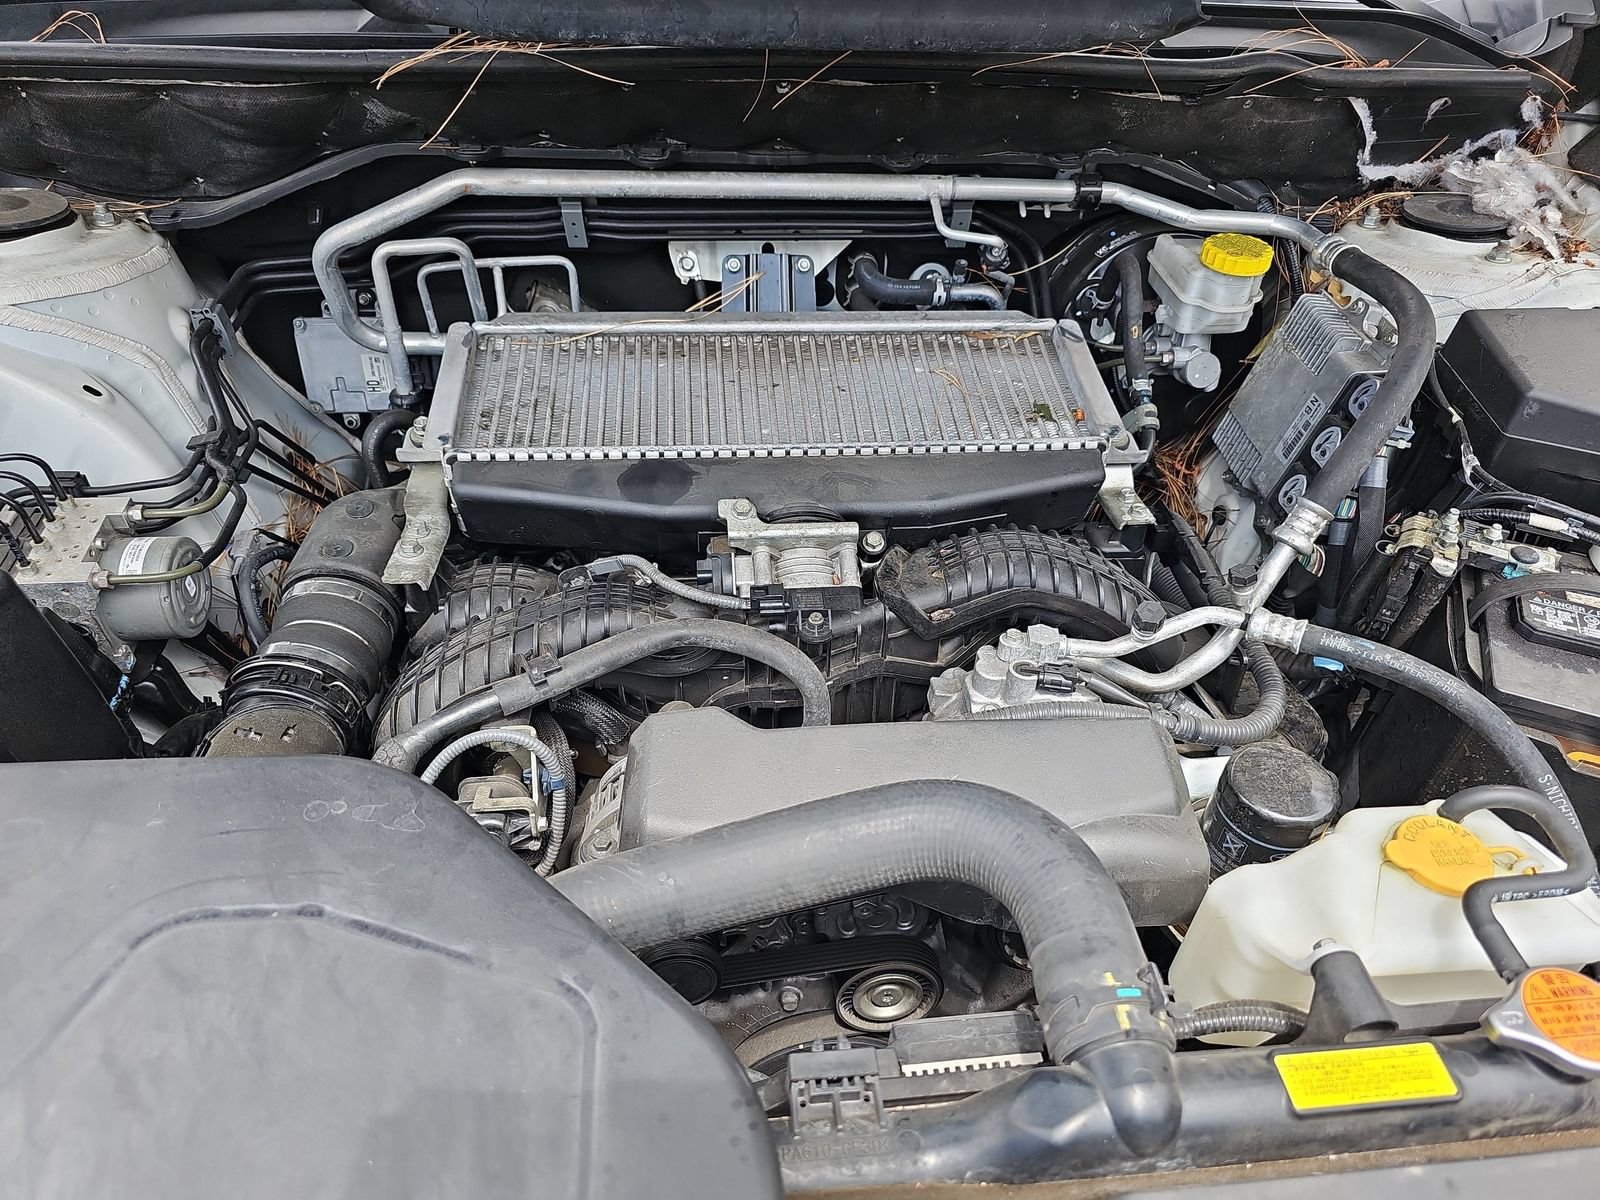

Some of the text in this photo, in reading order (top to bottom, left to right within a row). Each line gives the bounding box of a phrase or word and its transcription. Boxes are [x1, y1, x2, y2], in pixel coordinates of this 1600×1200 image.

[1543, 598, 1586, 614] DANGER
[1403, 818, 1471, 842] COOLANT
[1550, 984, 1593, 999] WARNING
